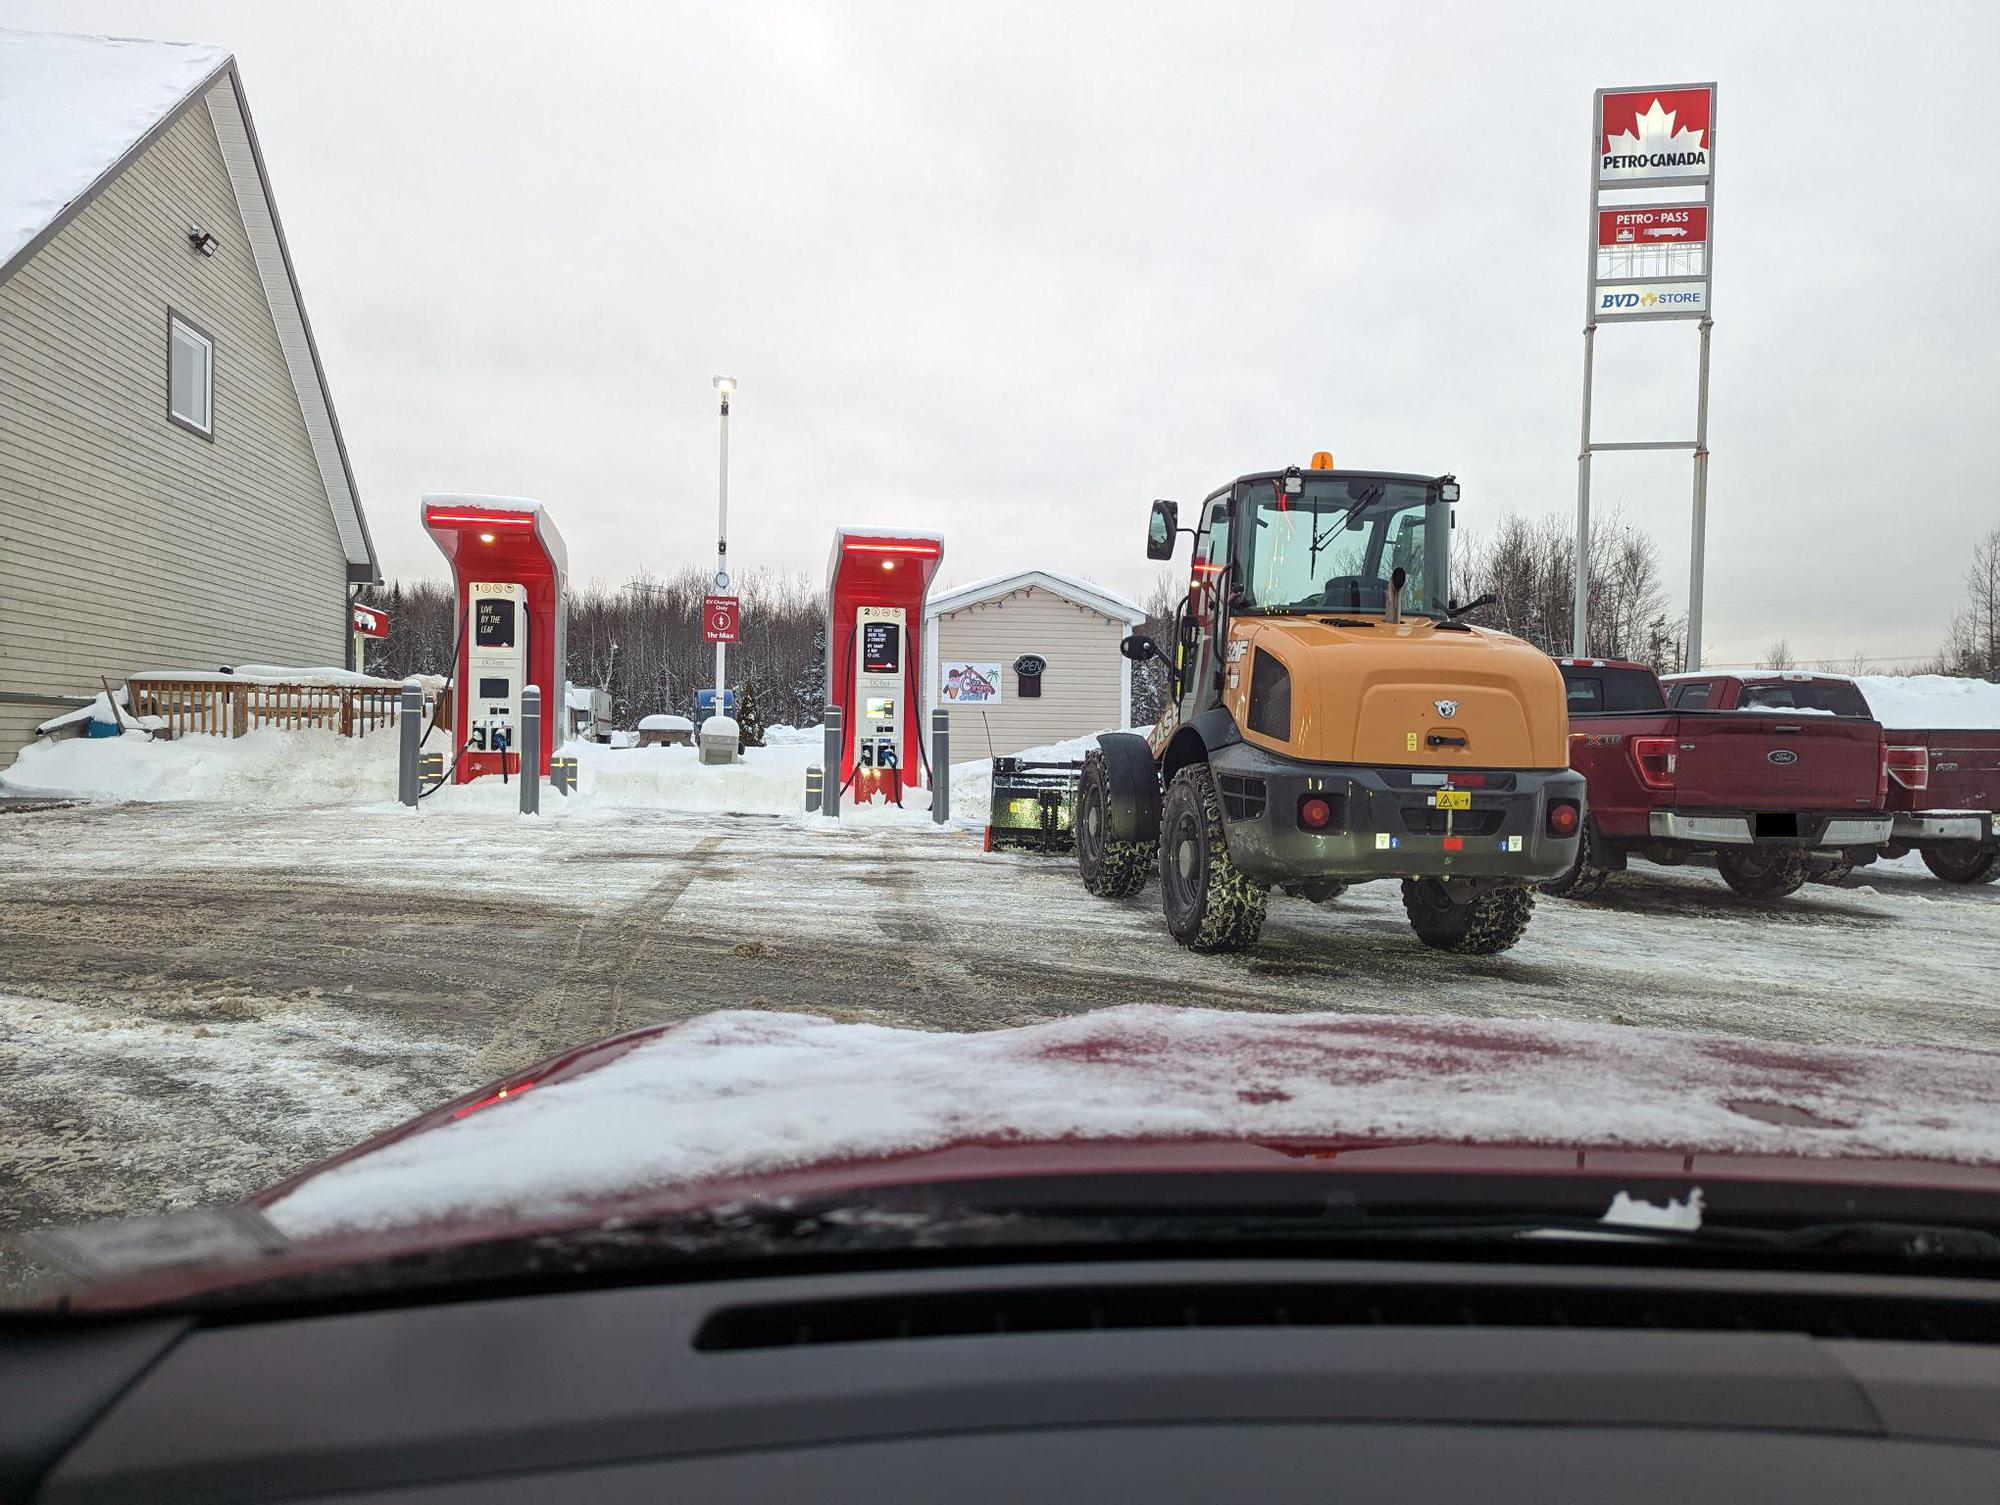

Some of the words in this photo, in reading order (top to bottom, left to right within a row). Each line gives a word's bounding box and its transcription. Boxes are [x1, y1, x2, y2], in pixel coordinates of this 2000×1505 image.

[1603, 152, 1706, 169] PETRO-CANADA
[1601, 293, 1640, 308] BVD
[1658, 292, 1701, 304] STORE
[475, 584, 479, 592] 1
[714, 599, 737, 607] Charging
[480, 606, 493, 614] LIVE
[480, 616, 489, 624] BY
[490, 616, 501, 624] THE
[480, 625, 494, 634] LEAF
[1017, 660, 1043, 671] OPEN
